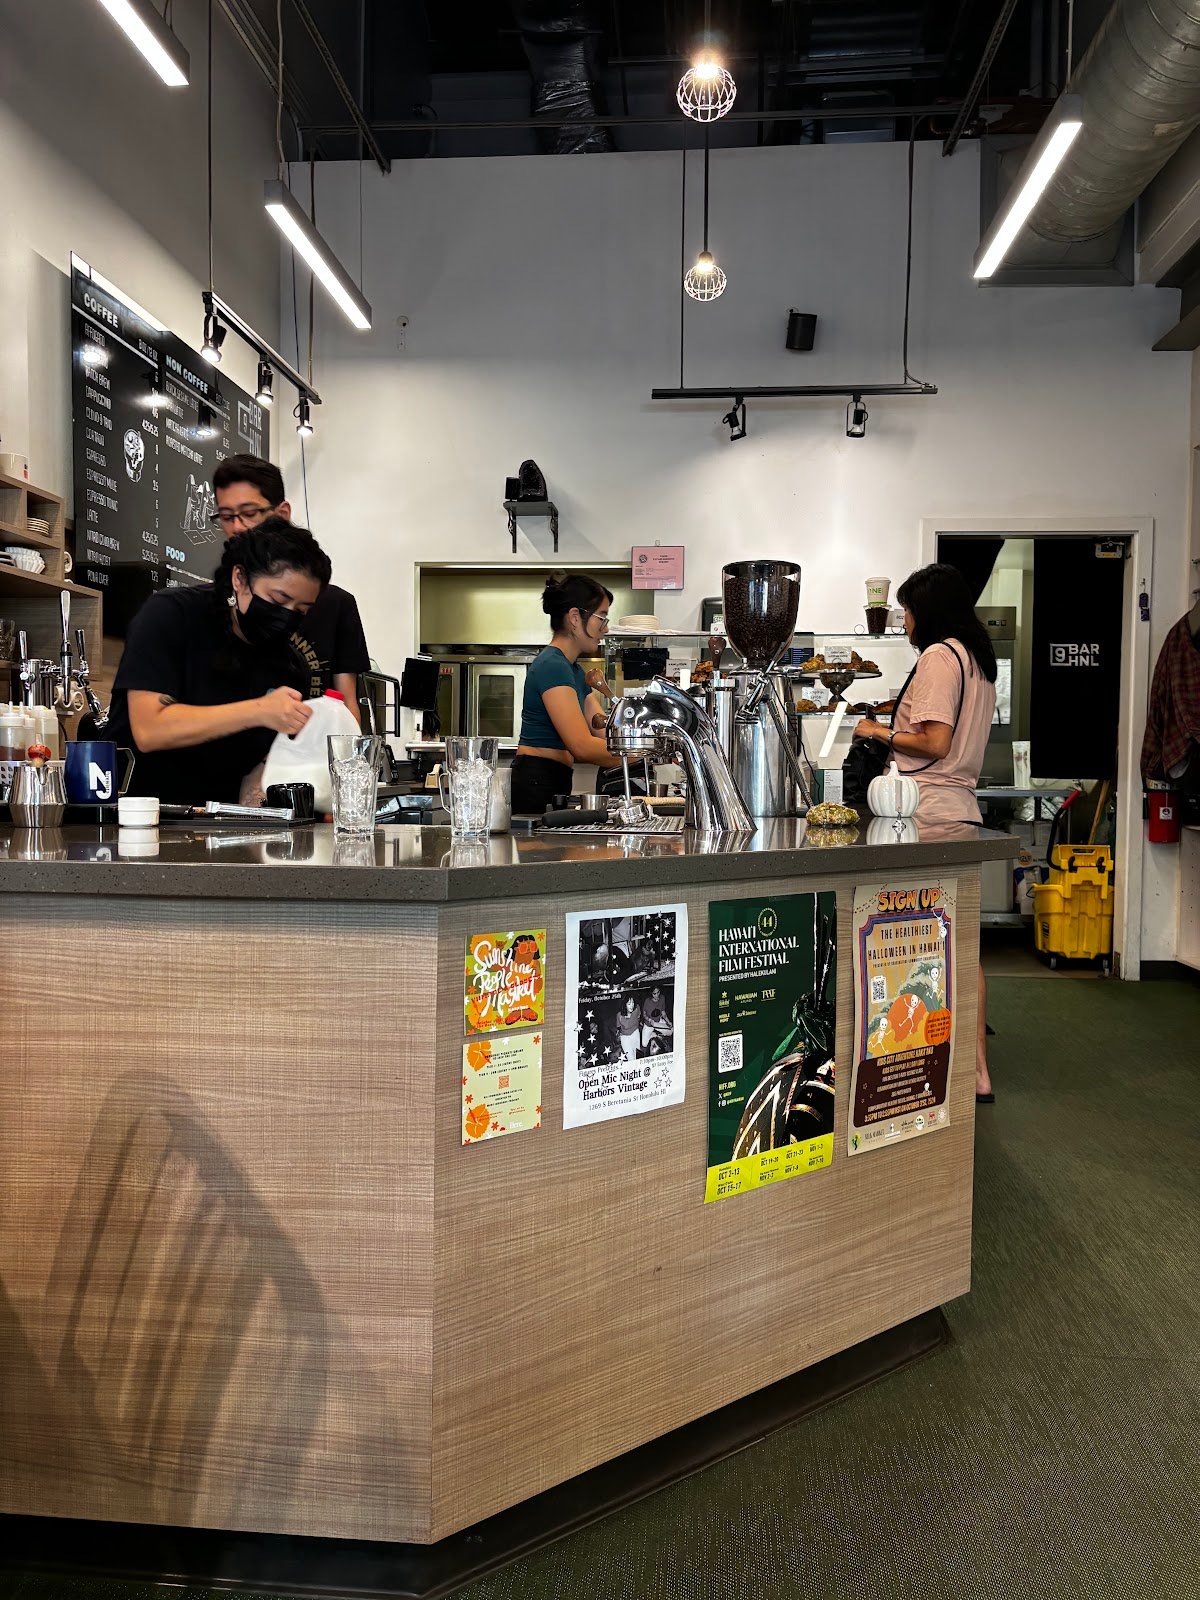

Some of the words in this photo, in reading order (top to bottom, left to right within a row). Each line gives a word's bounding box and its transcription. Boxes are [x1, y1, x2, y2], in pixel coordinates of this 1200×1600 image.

[83, 292, 119, 329] COFFEE
[165, 354, 182, 375] NON
[182, 367, 209, 395] COFFEE
[242, 413, 248, 432] 9
[86, 447, 107, 467] ESPRESSO
[86, 468, 107, 487] ESPRESSO
[86, 488, 107, 507] ESPRESSO
[107, 497, 118, 512] TONIC
[87, 508, 98, 523] LATTE
[165, 545, 186, 563] FOOD
[290, 632, 320, 671] NNER
[1055, 647, 1065, 662] 9
[1068, 643, 1100, 655] BAR
[1068, 655, 1100, 667] HNL
[877, 889, 918, 913] SIGN
[919, 887, 940, 909] UP
[763, 916, 772, 928] 44
[881, 929, 892, 940] THE
[895, 924, 933, 939] HEALTHIEST
[473, 940, 533, 974] Sunshine
[719, 936, 800, 958] INTERNATIONAL
[867, 945, 907, 961] HALLOWEEN
[909, 944, 916, 954] IN
[719, 957, 742, 973] FILM
[744, 952, 790, 970] FESTIVAL
[473, 967, 513, 995] People
[719, 973, 743, 982] PRESENTED
[750, 968, 776, 977] HALEKULANI
[578, 1079, 598, 1090] Open
[602, 1074, 617, 1083] Mic
[620, 1070, 641, 1082] Night
[644, 1067, 651, 1077] @
[583, 1086, 615, 1101] Harbors
[617, 1080, 648, 1093] Vintage
[589, 1102, 601, 1111] 1269
[607, 1098, 632, 1106] Beretania
[639, 1090, 659, 1100] Honolulu
[718, 1171, 727, 1180] OCT
[717, 1186, 726, 1195] OCT
